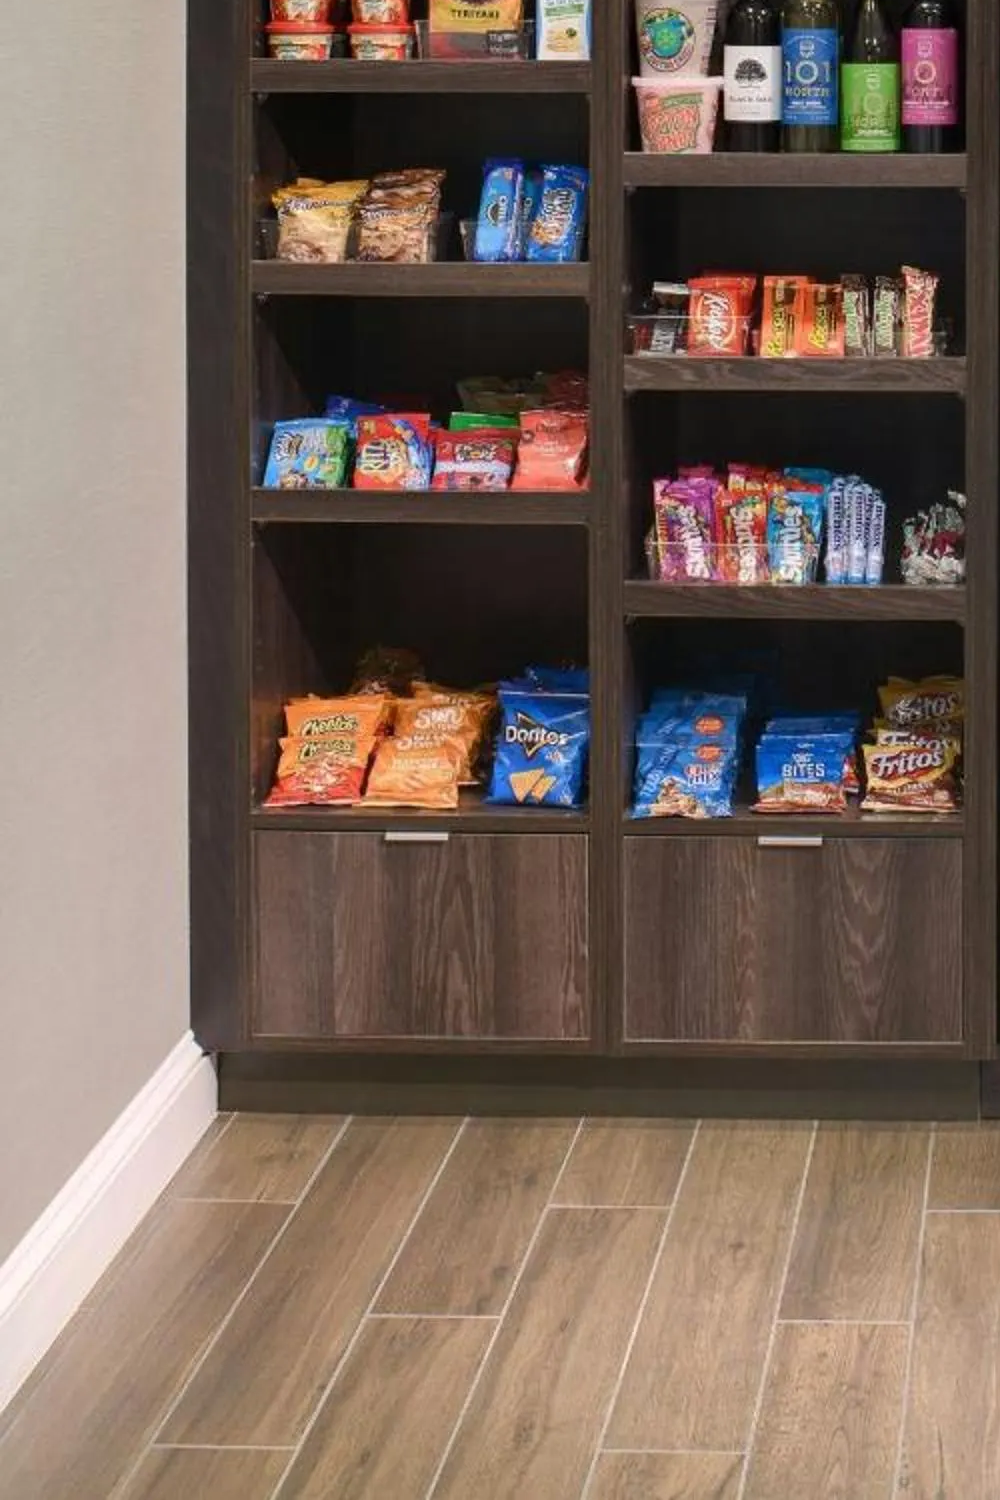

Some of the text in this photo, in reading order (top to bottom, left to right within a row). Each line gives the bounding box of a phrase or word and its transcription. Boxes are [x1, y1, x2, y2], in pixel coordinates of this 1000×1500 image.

[505, 725, 569, 746] Doritos
[782, 762, 826, 779] BITES
[871, 751, 943, 779] Fritos
